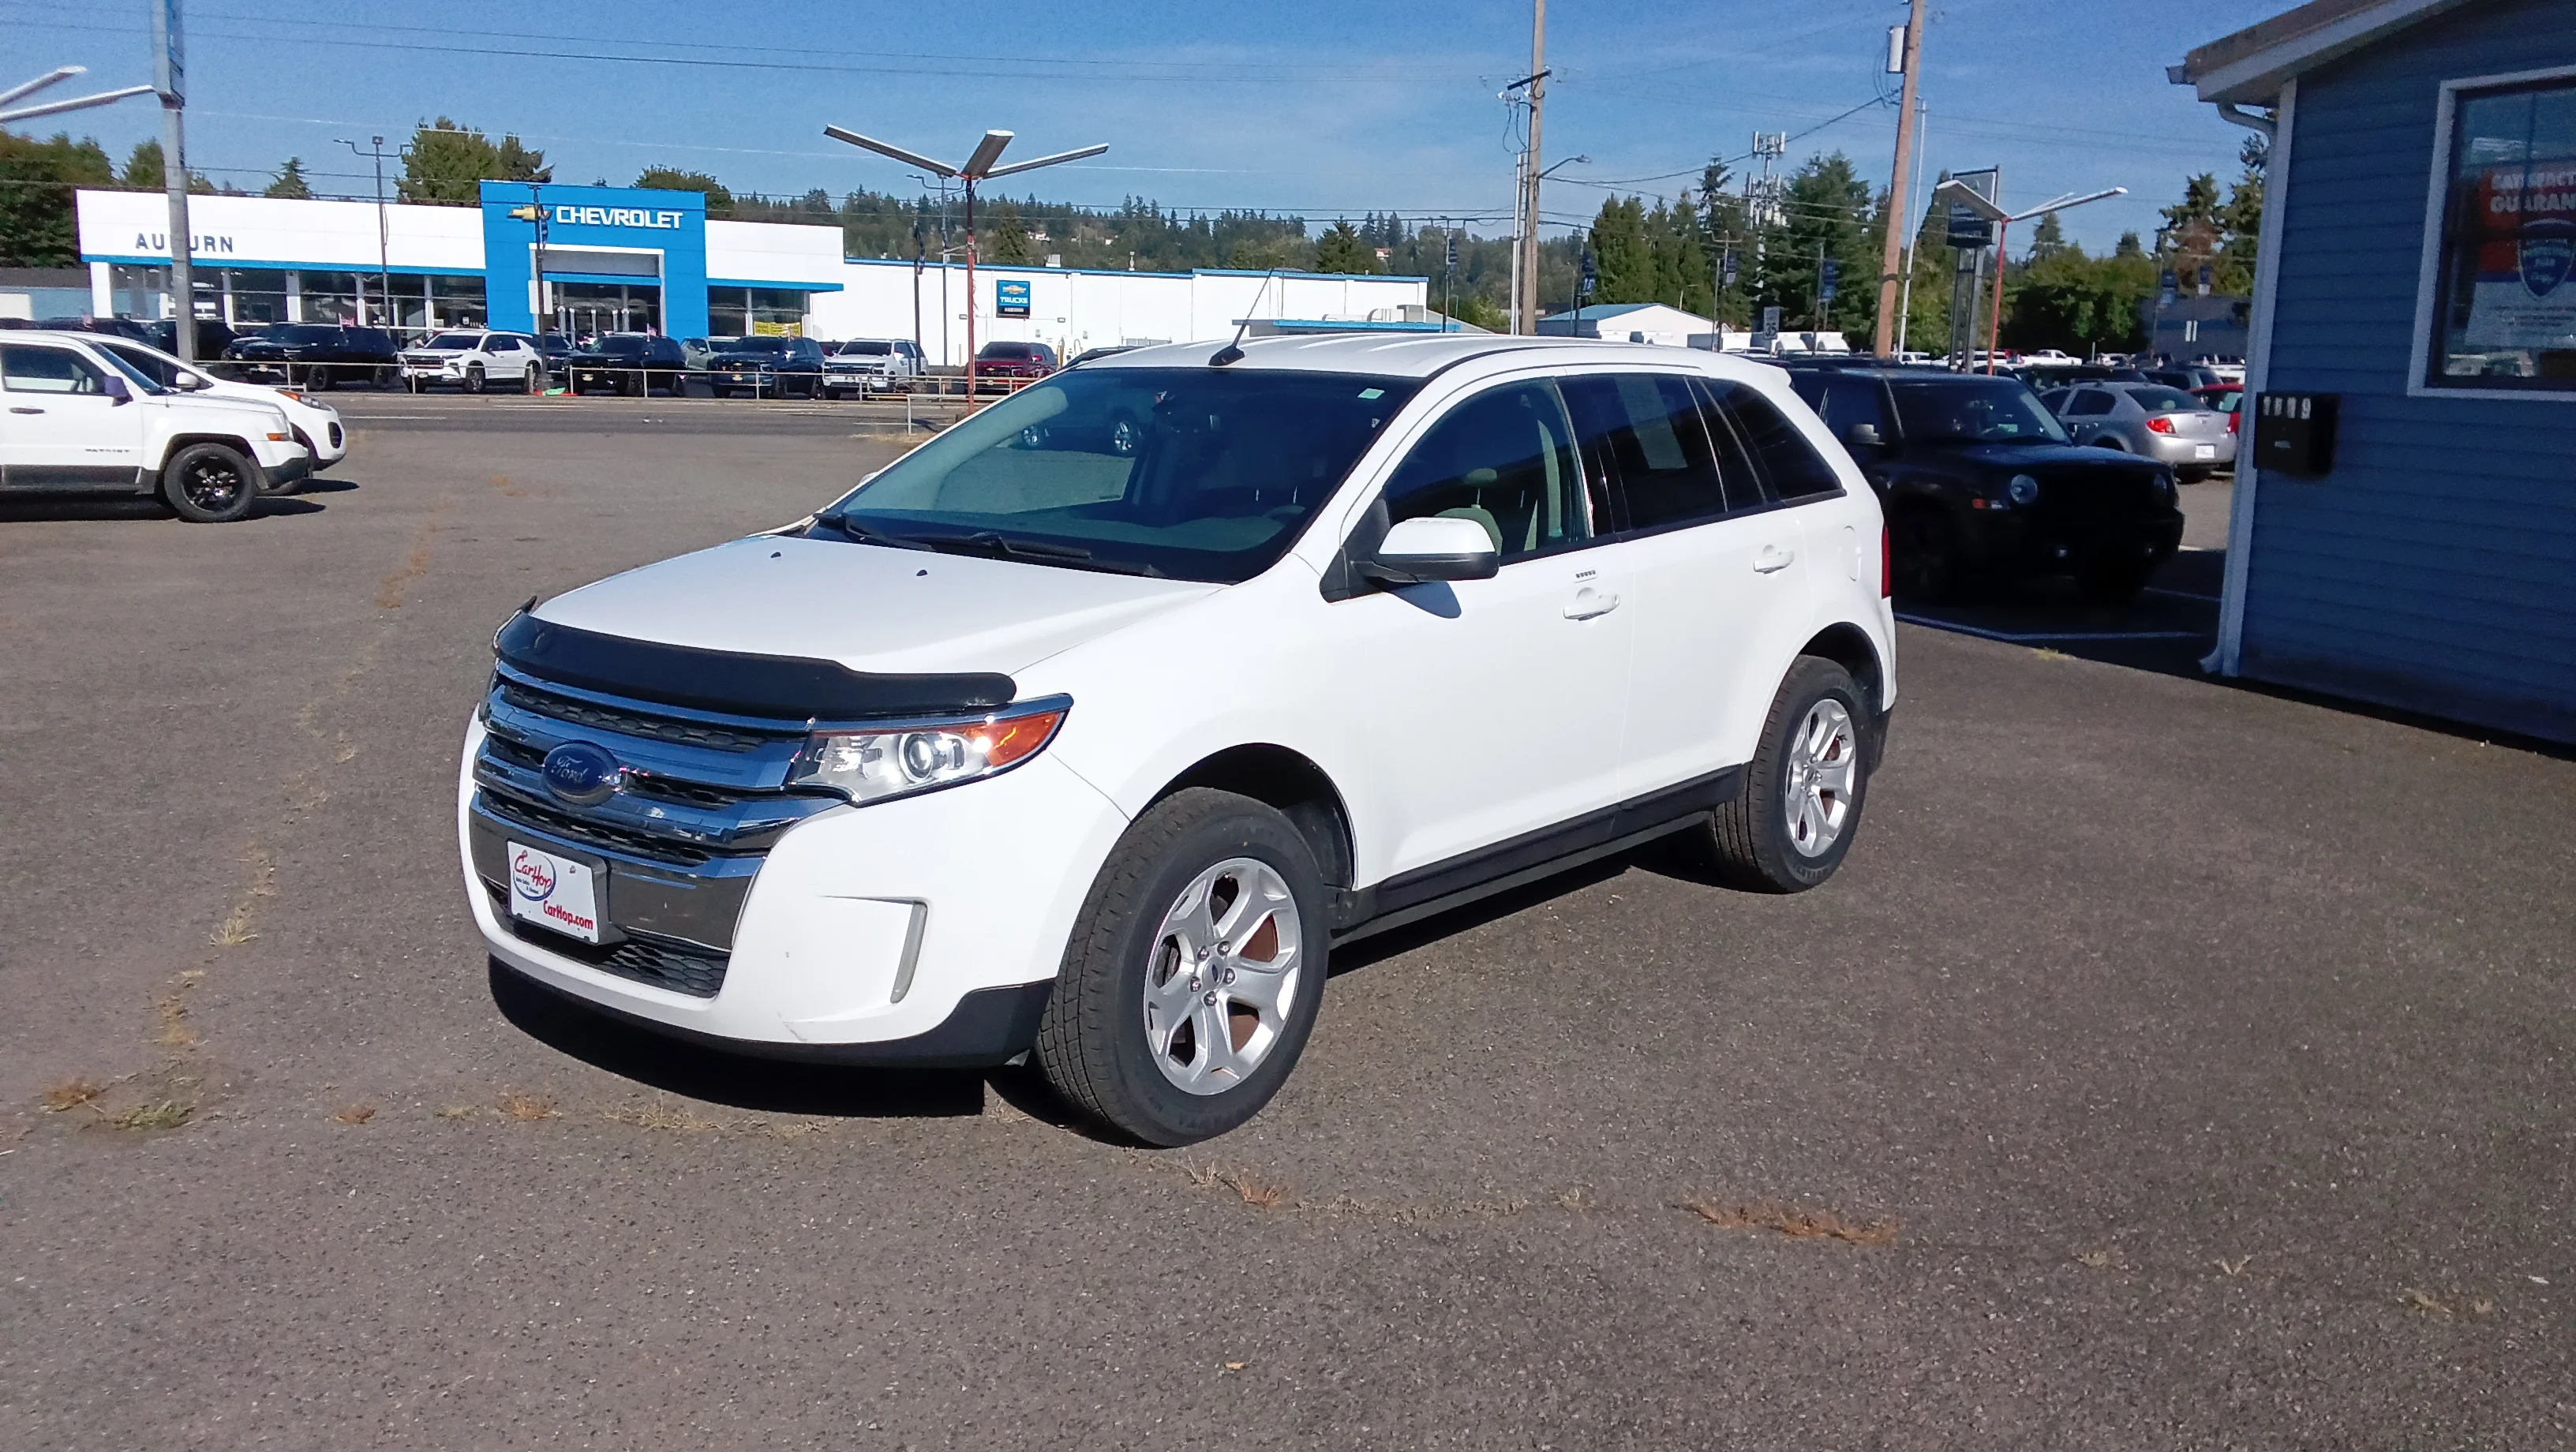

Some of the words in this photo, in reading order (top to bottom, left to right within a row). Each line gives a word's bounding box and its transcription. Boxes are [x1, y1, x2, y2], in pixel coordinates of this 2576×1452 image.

[556, 205, 684, 230] CHEVROLET
[135, 232, 234, 253] AUURN
[999, 296, 1028, 305] TRUCKS
[554, 755, 590, 784] Ford
[514, 854, 552, 895] CarHop
[543, 900, 593, 930] CarHop.com
